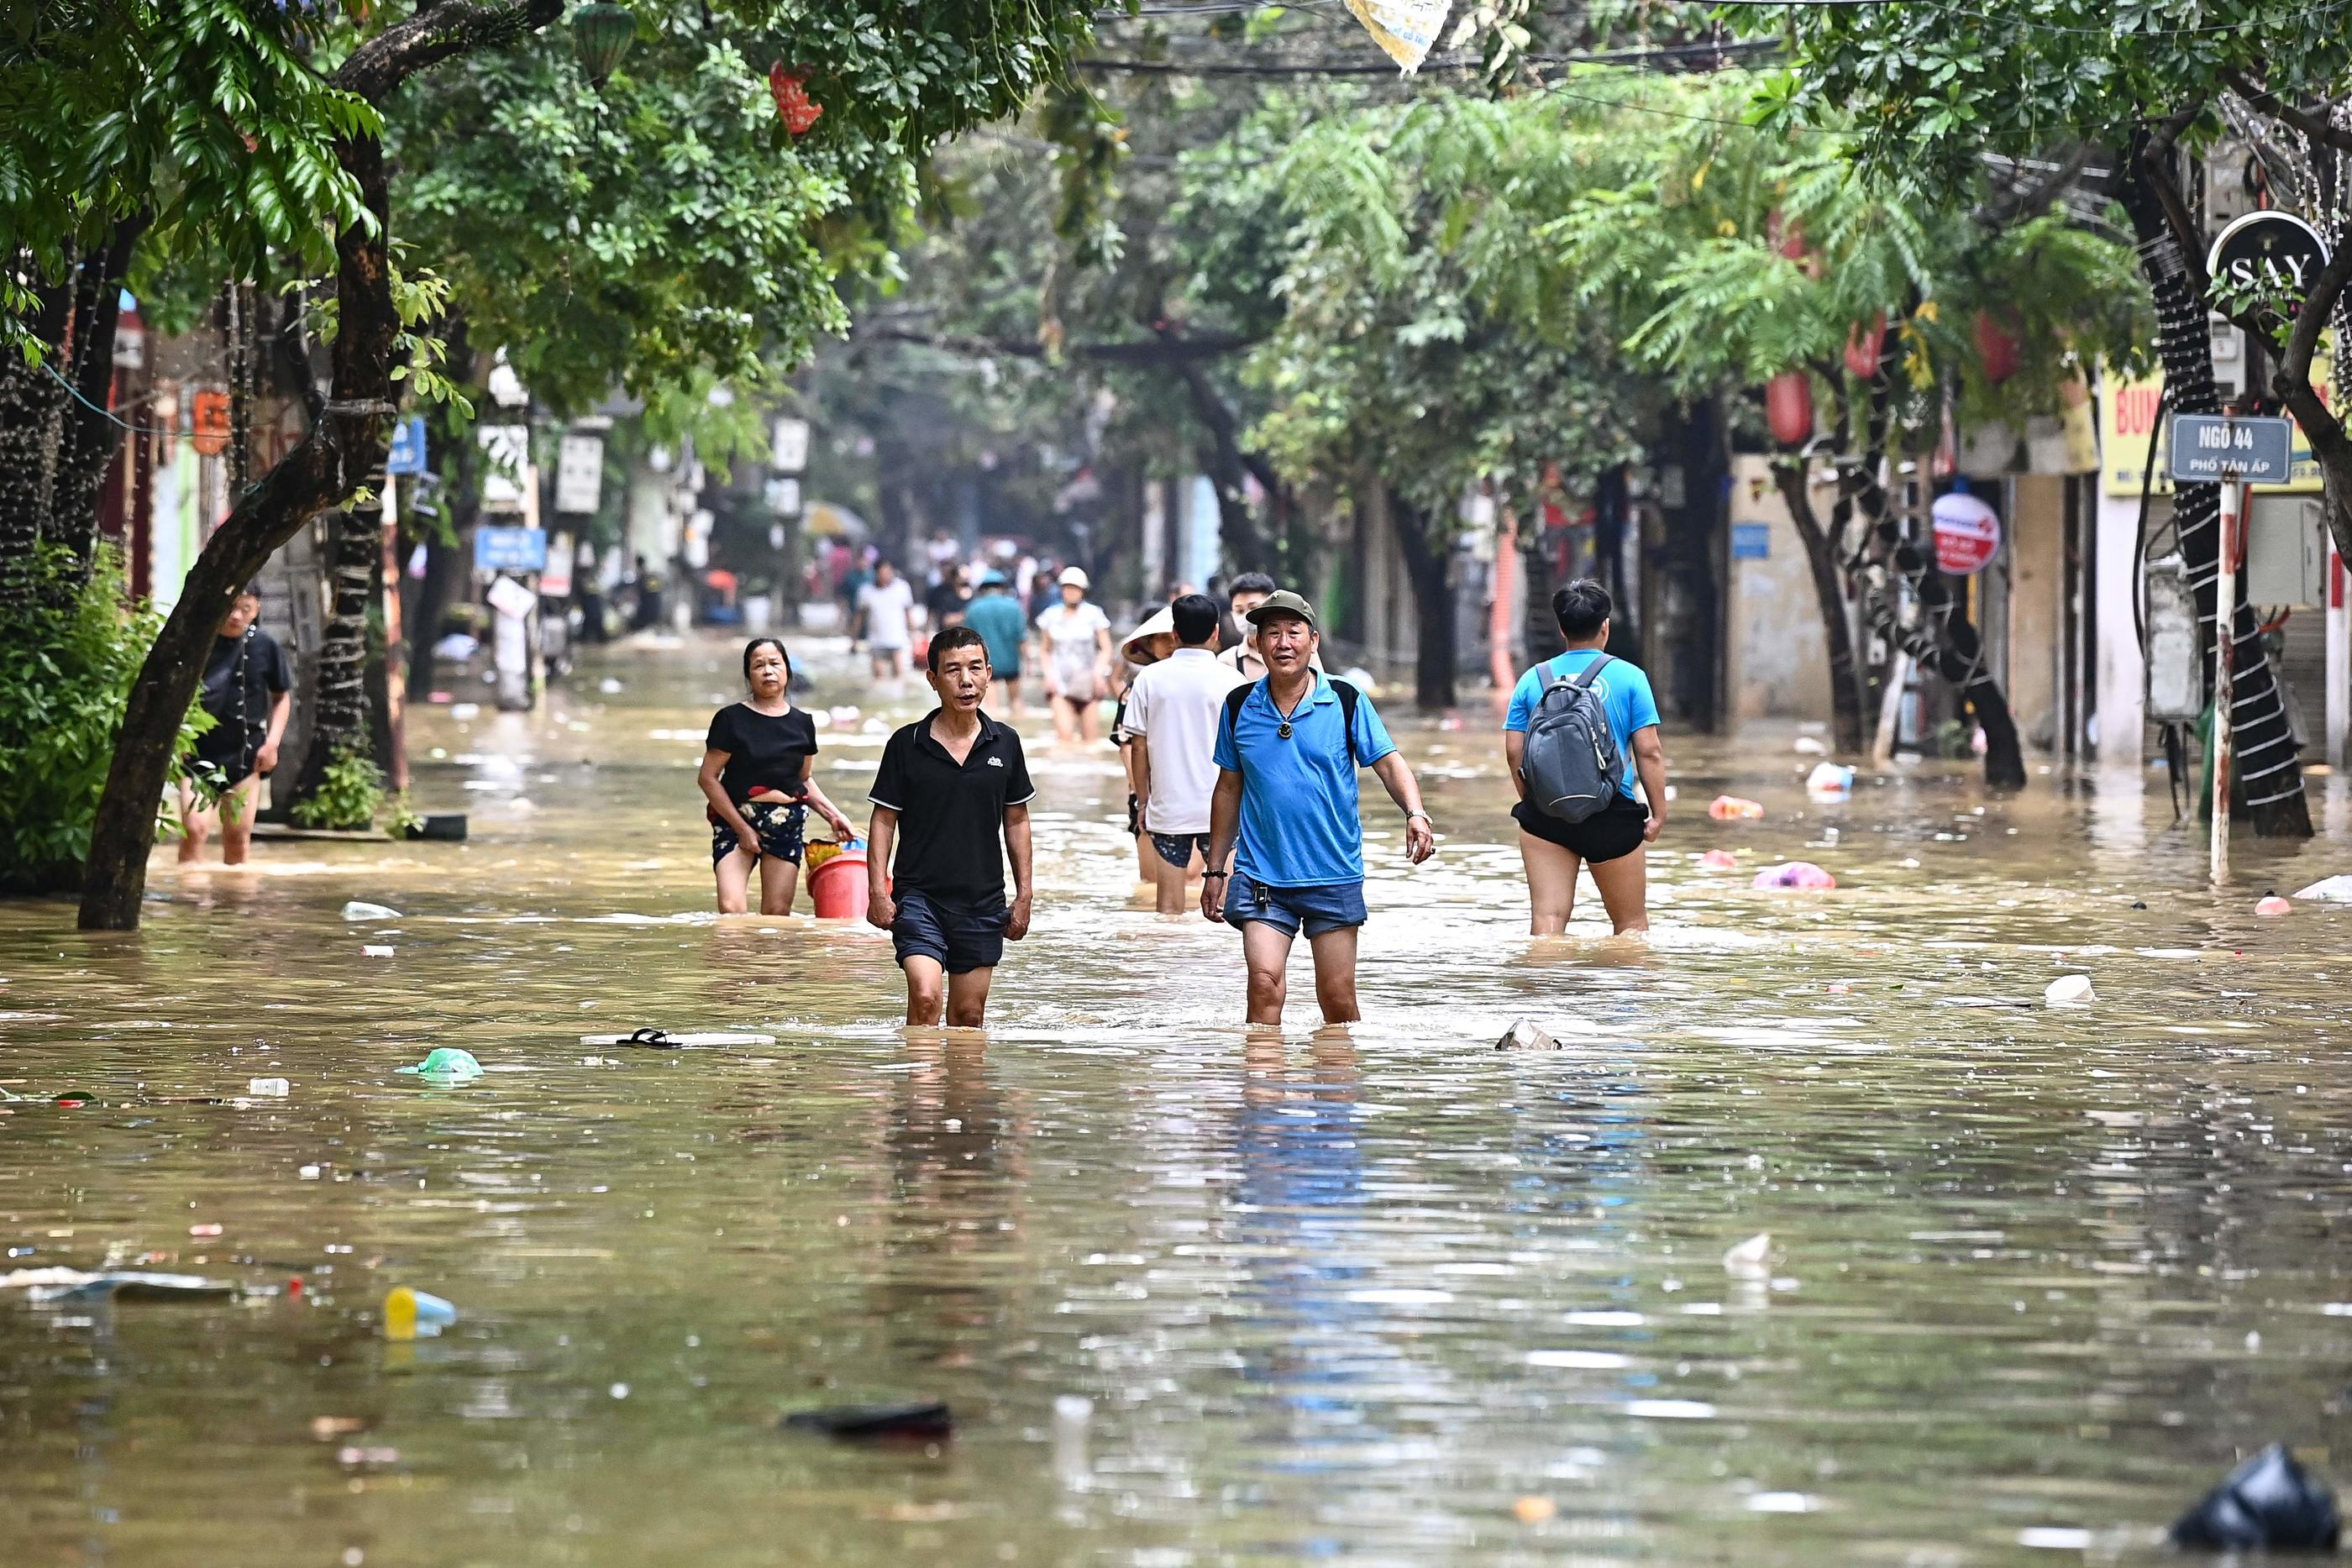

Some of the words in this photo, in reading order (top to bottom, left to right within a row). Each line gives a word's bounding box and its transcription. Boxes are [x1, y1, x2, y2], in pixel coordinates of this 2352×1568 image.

[2231, 254, 2312, 290] SAY
[2234, 427, 2254, 449] 44
[2190, 455, 2218, 472] PHỐ
[2221, 458, 2249, 473] TÂN
